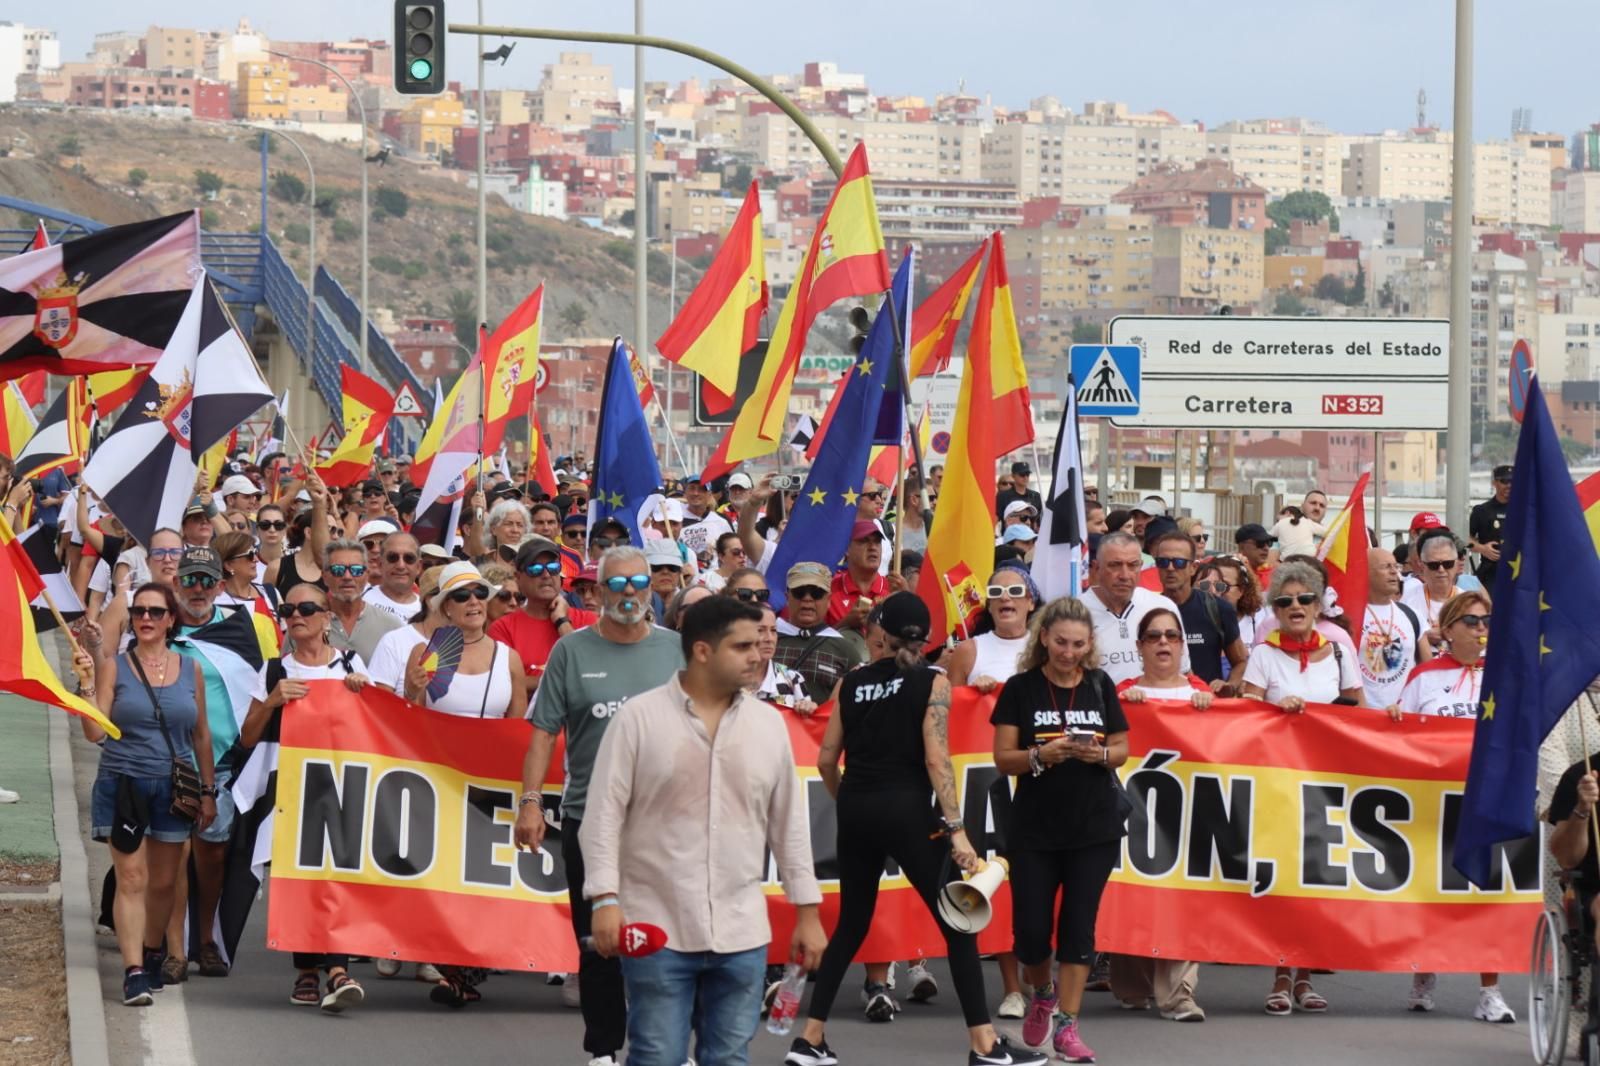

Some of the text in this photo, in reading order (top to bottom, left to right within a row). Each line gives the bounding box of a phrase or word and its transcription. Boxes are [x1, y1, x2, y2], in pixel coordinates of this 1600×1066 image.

[1168, 339, 1442, 357] Red de Carreteras del Estado
[802, 357, 853, 371] ADON
[1185, 395, 1381, 415] Carretera N-352
[297, 759, 439, 879] NO
[1300, 782, 1413, 892] ES
